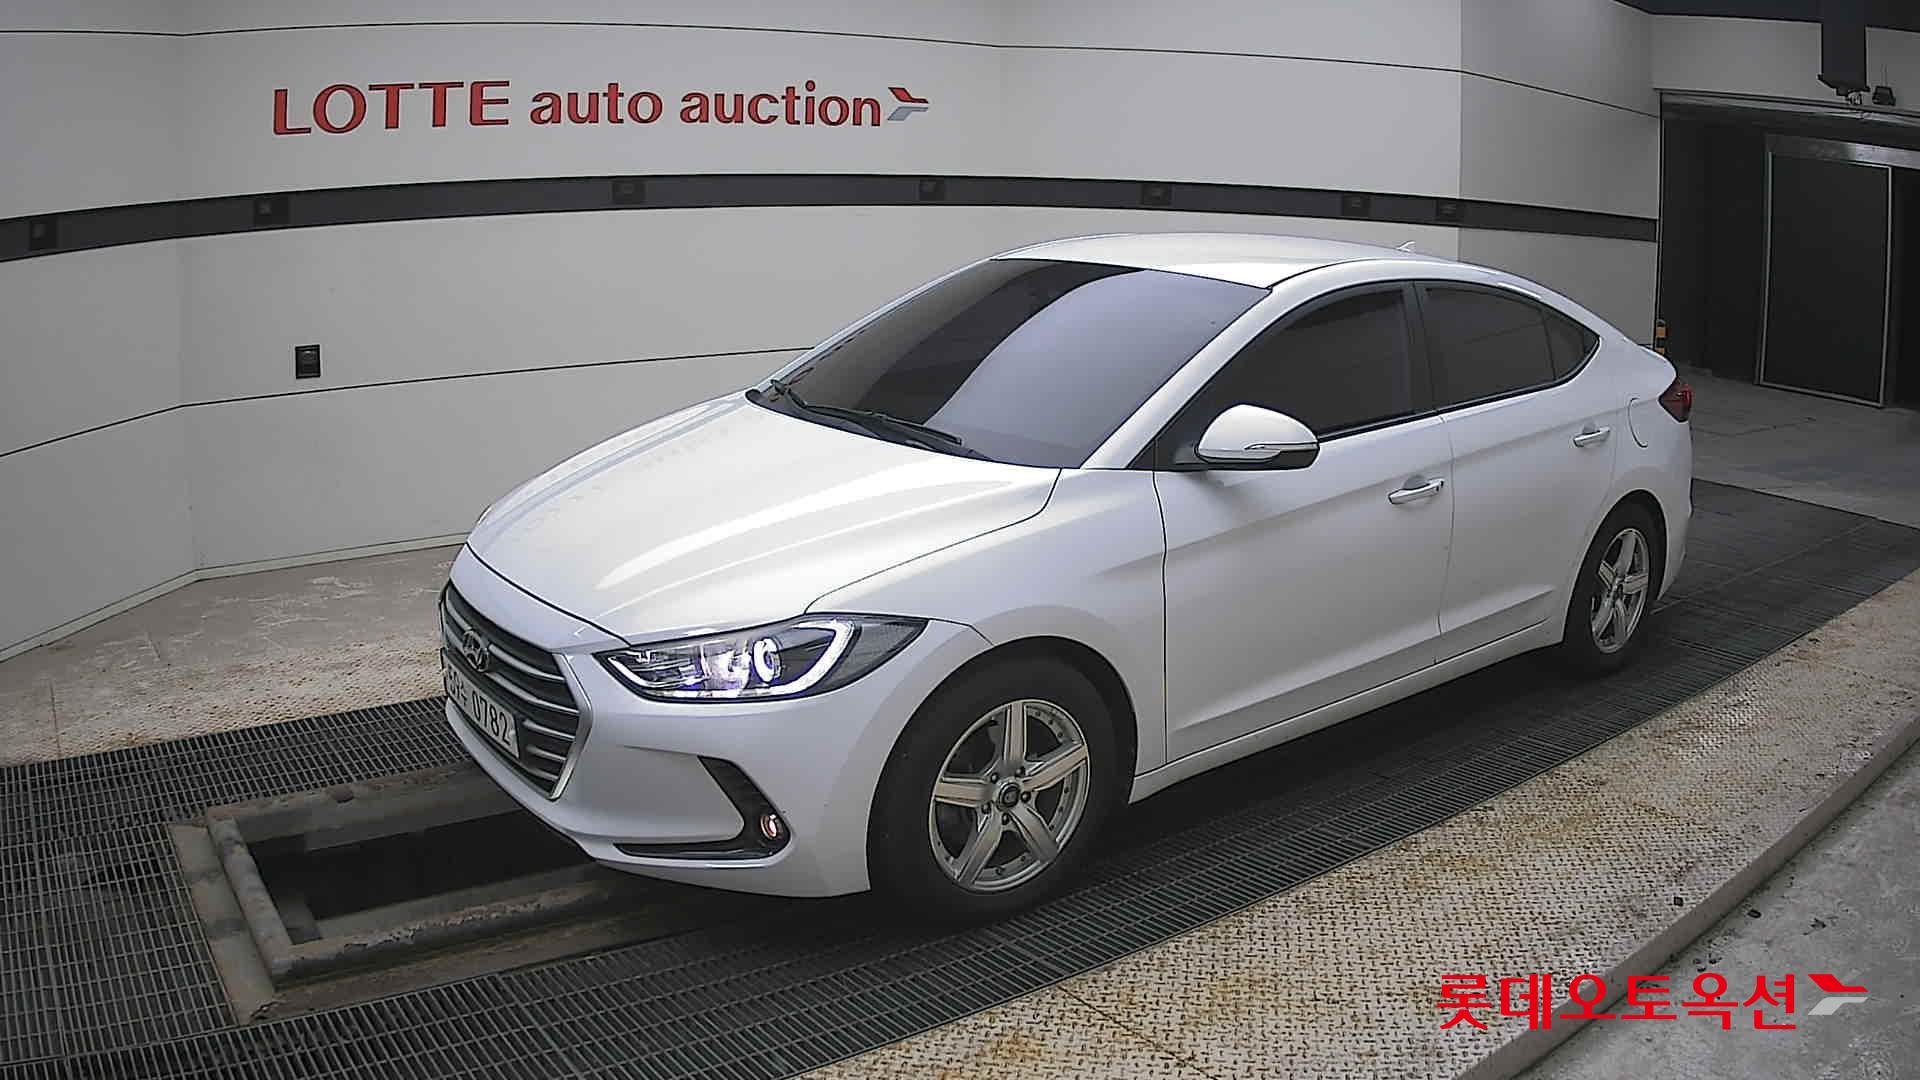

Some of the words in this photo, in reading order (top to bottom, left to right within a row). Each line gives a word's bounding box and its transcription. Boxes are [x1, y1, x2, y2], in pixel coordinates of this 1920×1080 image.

[272, 80, 511, 135] LOTTE
[530, 82, 664, 125] auto
[679, 79, 882, 127] auction
[472, 690, 511, 746] 0782
